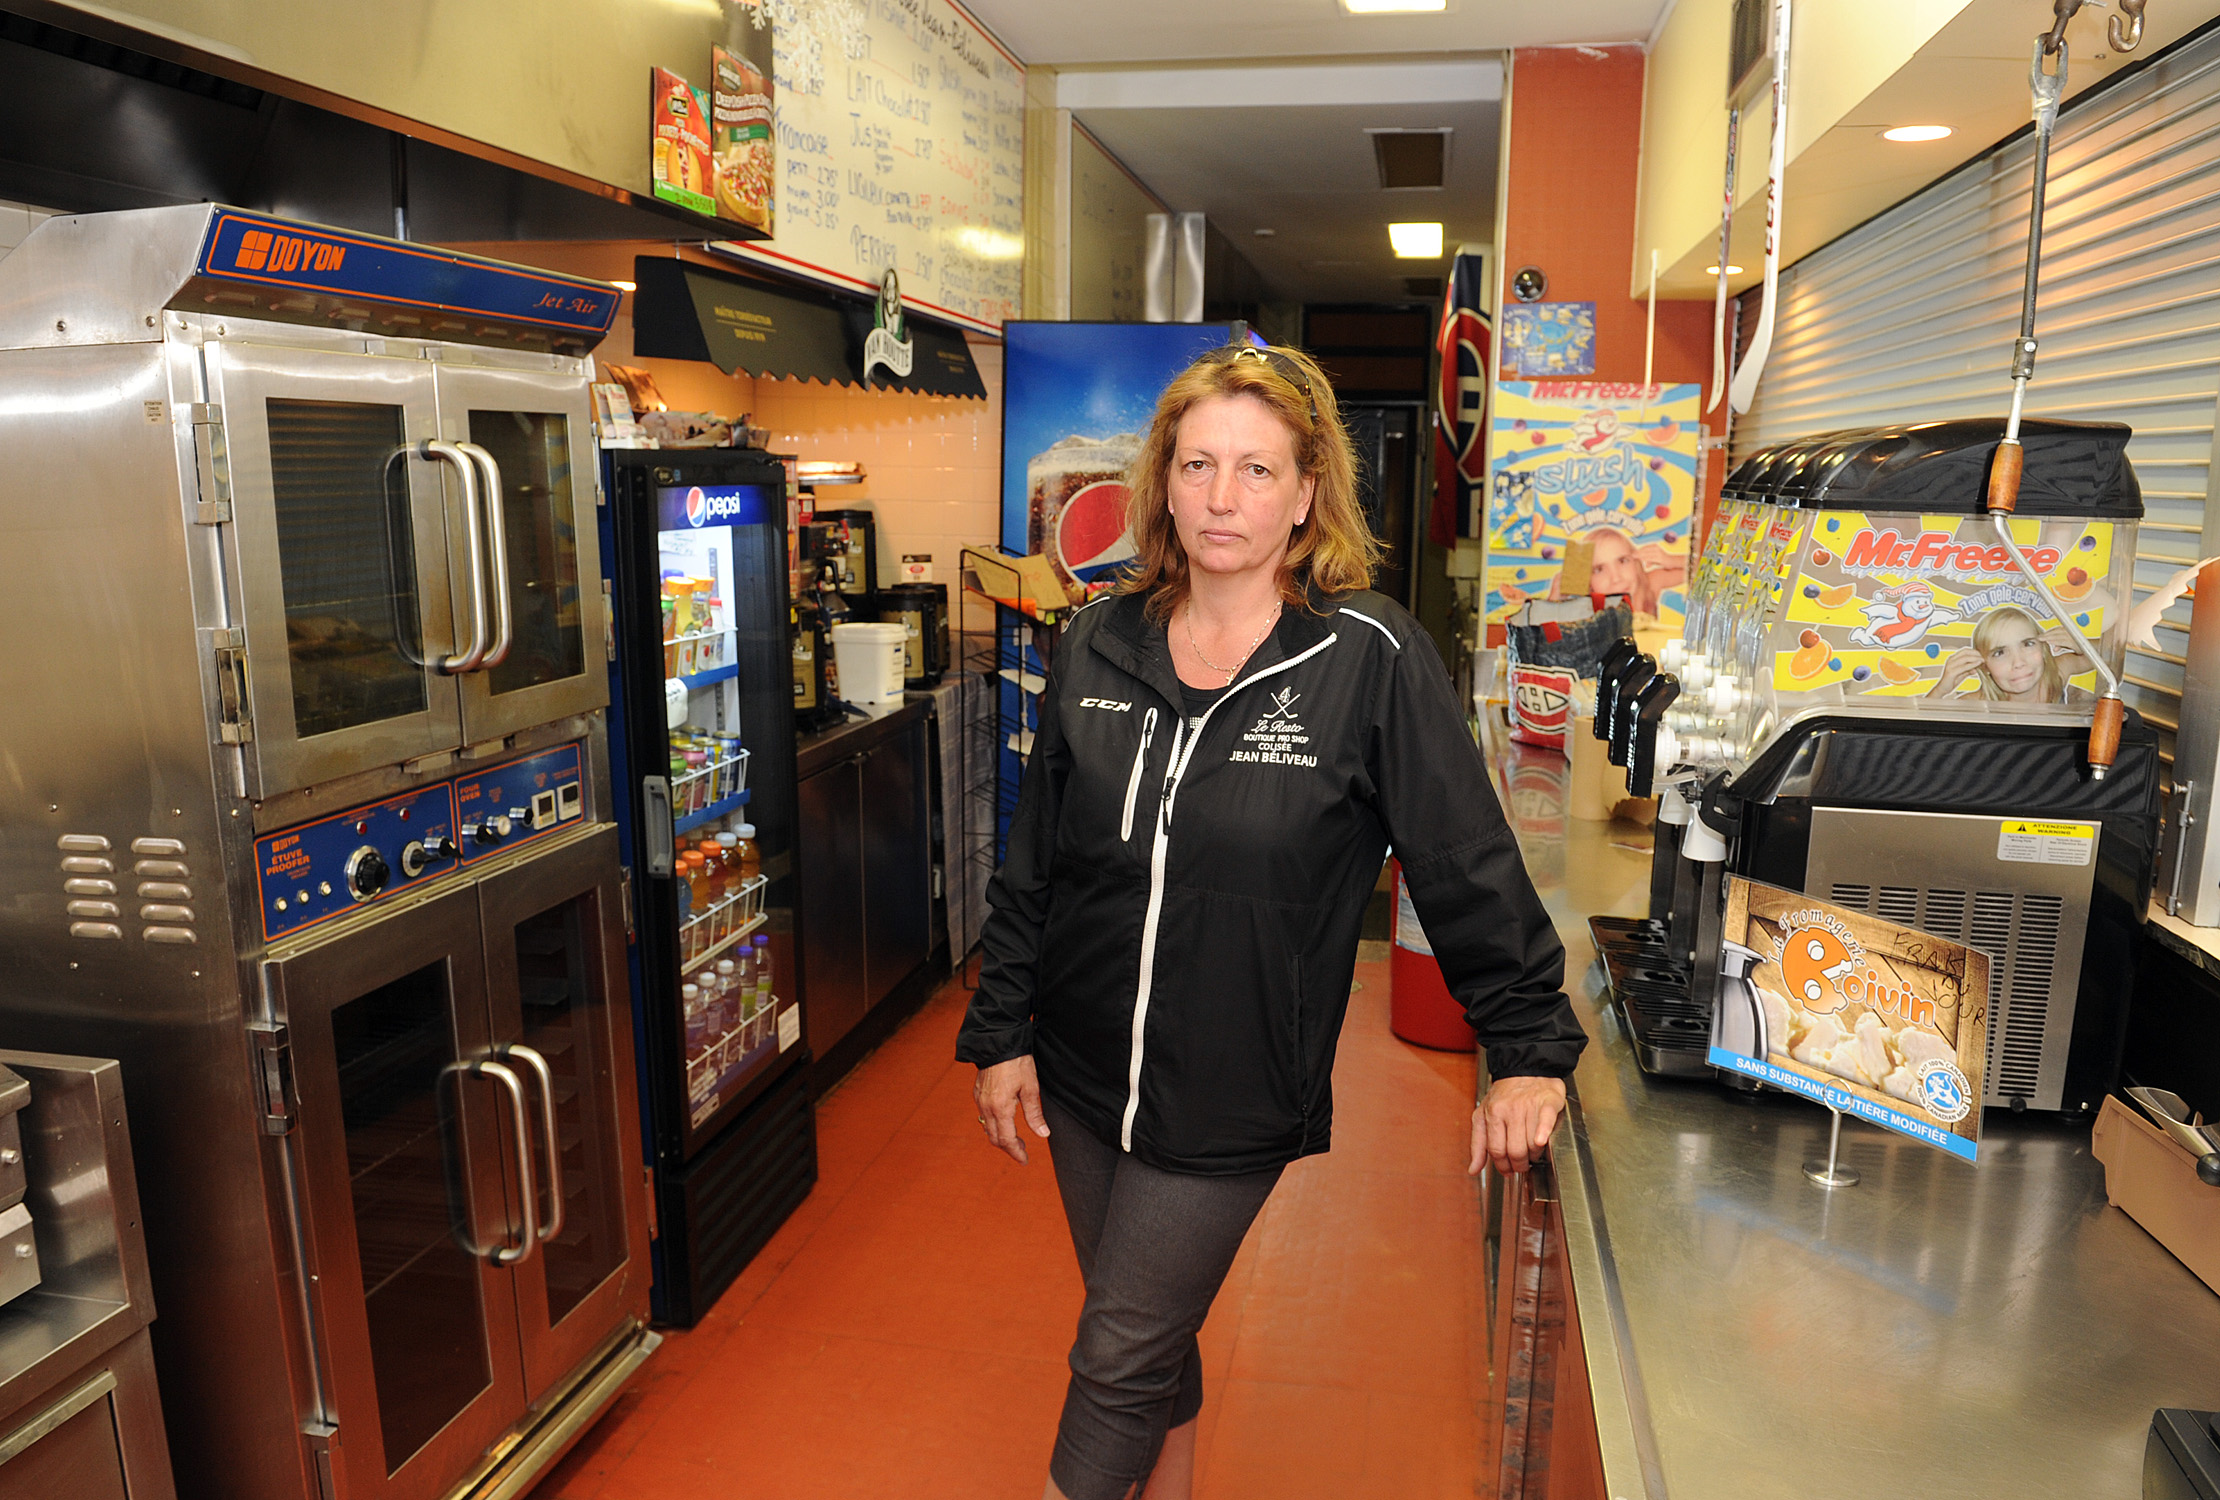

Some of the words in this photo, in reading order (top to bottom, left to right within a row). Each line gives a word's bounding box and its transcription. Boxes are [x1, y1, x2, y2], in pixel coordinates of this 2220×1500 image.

[266, 233, 346, 273] DOYON
[532, 291, 566, 310] Jet
[569, 297, 600, 315] Air
[706, 491, 741, 521] pepsi
[1960, 592, 1988, 614] Zone
[1079, 697, 1133, 712] CCM
[1250, 719, 1269, 734] Le
[1269, 720, 1305, 733] Resto
[1243, 733, 1276, 742] BOUTIQUE
[1277, 734, 1290, 743] PRO
[1291, 735, 1309, 744] SHOP
[1258, 740, 1292, 752] COLISÉE
[1229, 750, 1260, 762] JEAN
[1261, 749, 1318, 768] BÉLIVEAU
[460, 791, 481, 803] OVEN
[2032, 823, 2078, 831] ATTENZIONE
[266, 855, 311, 876] PROOFER
[271, 848, 302, 866] ÉTUVE
[1767, 936, 1784, 966] La
[1779, 908, 1867, 967] Fromagerie
[1918, 1063, 1929, 1077] LAIT
[1945, 1062, 1970, 1094] CANADIEN
[1736, 1056, 1768, 1077] SANS
[1768, 1068, 1835, 1102] SUBSTANCE
[1836, 1092, 1889, 1122] LAITIÈRE
[1890, 1113, 1949, 1146] MODIFIÉE
[1926, 1104, 1957, 1120] CANADIAN
[1956, 1104, 1968, 1118] MILK
